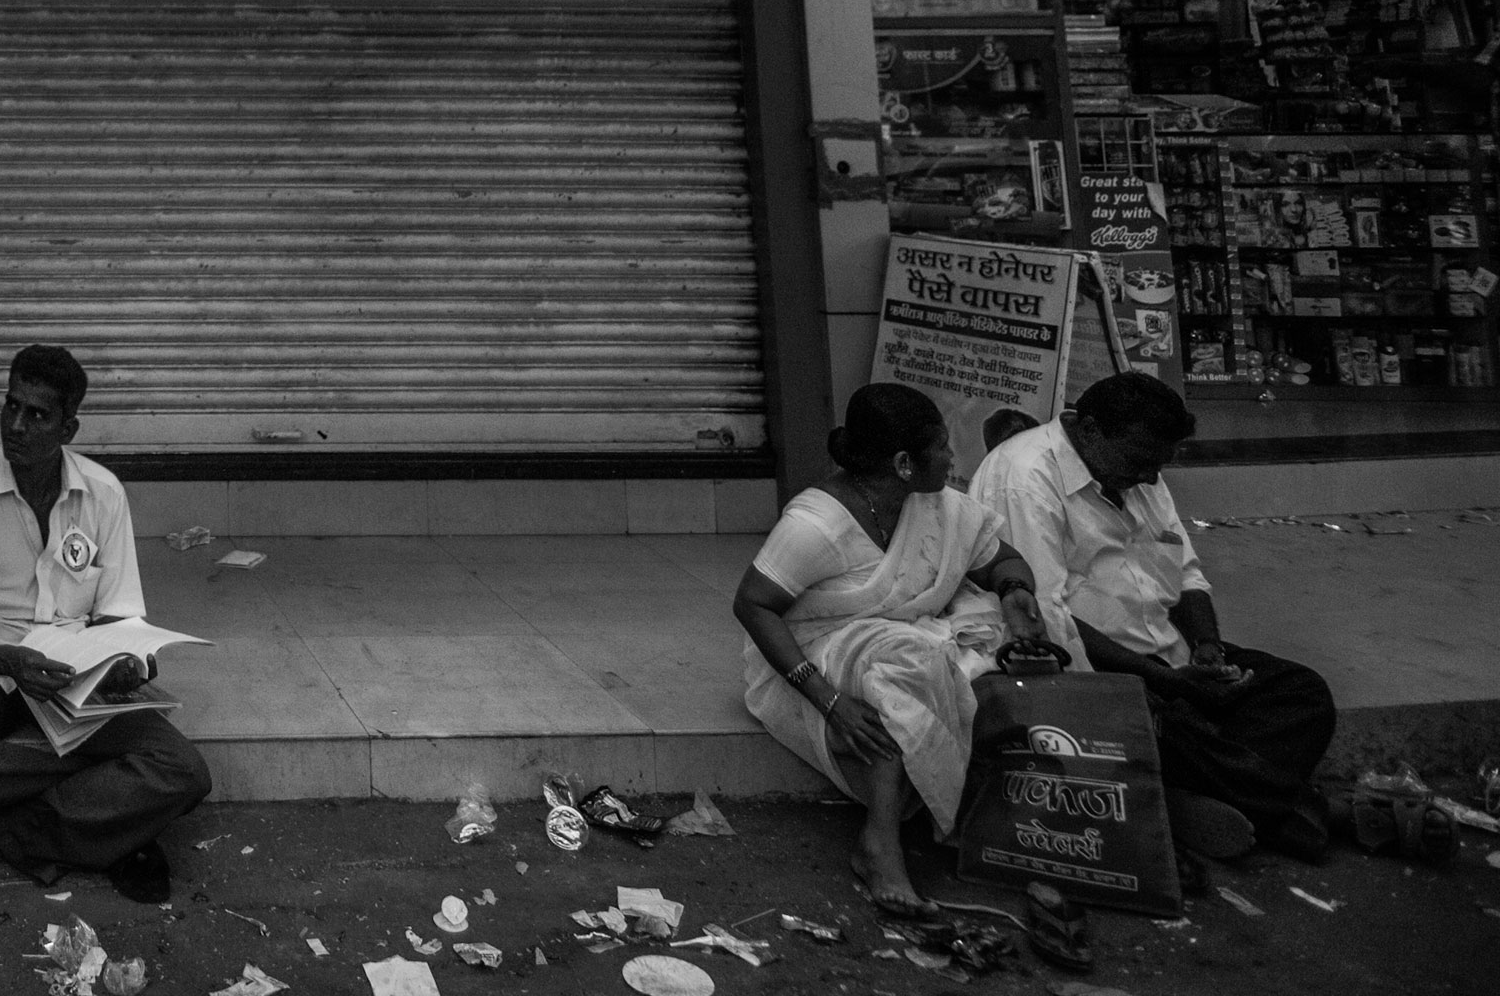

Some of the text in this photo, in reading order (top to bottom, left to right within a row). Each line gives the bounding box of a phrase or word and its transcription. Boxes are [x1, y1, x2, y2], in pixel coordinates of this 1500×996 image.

[1080, 176, 1144, 188] Great sta
[1095, 192, 1144, 205] to your
[1092, 207, 1151, 220] day with
[1091, 224, 1158, 249] Kellogg's
[897, 247, 953, 271] असर
[957, 255, 974, 273] न
[907, 269, 1044, 317] पैसे वापस
[1040, 326, 1051, 341] के
